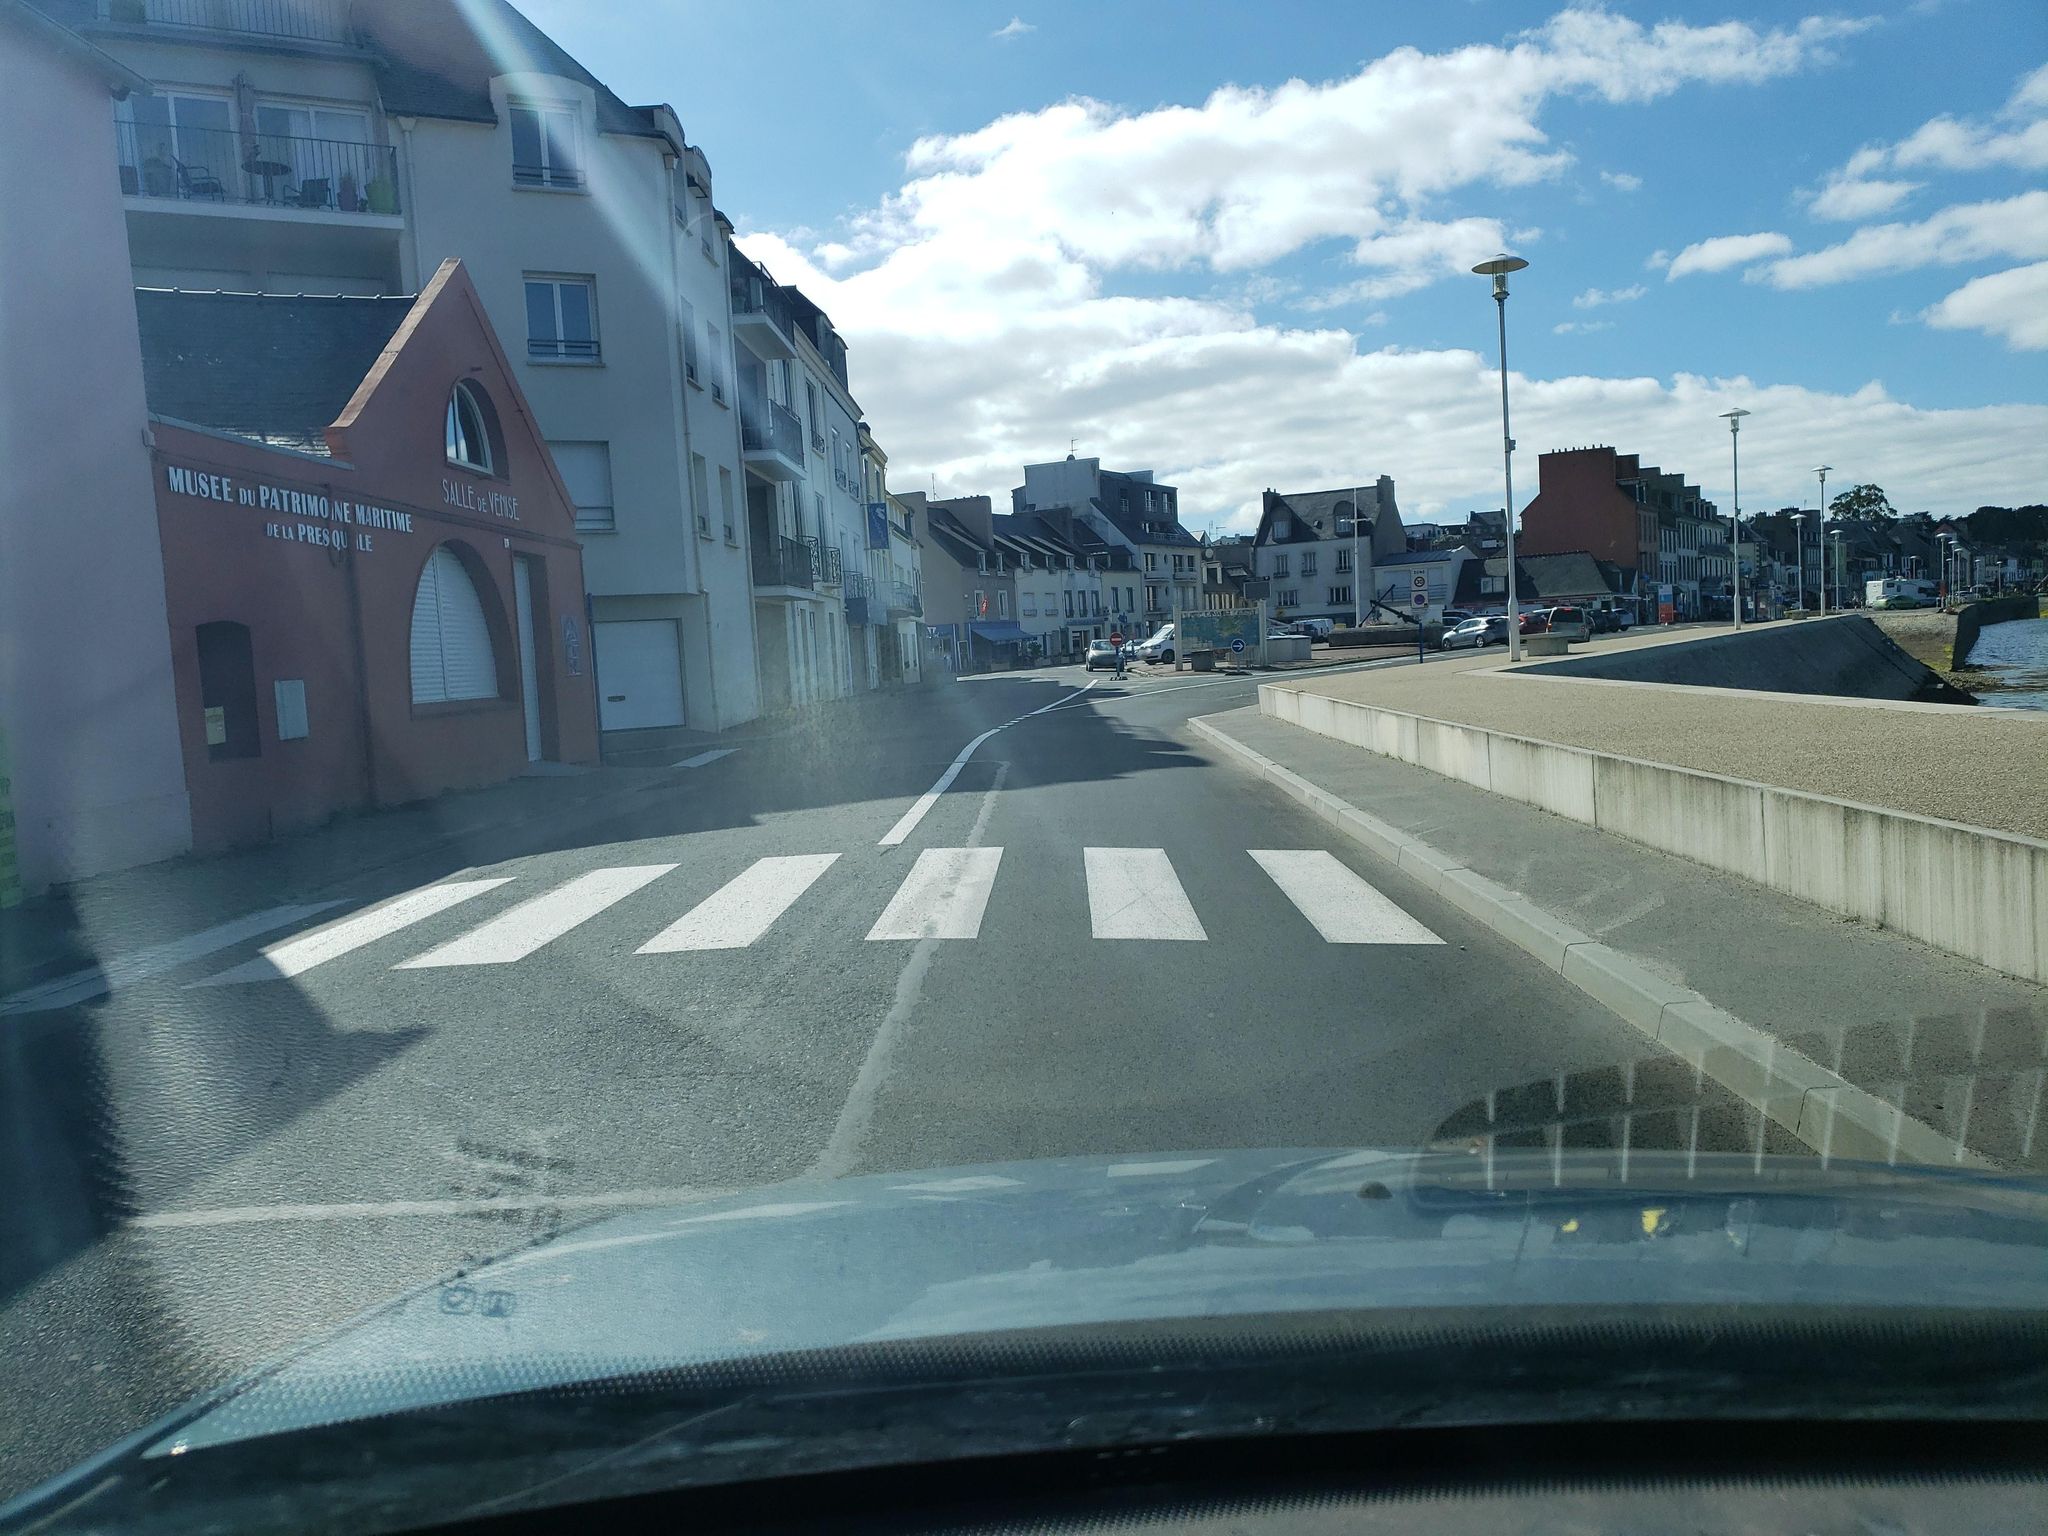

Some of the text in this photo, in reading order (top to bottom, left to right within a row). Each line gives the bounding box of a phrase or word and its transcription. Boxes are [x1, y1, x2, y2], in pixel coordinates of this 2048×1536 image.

[168, 466, 233, 502] MUSEE
[238, 487, 256, 507] DU
[355, 503, 414, 533] MARITIME
[442, 478, 520, 521] SALLE DE VENISE
[267, 522, 280, 539] DE
[282, 525, 295, 541] LA
